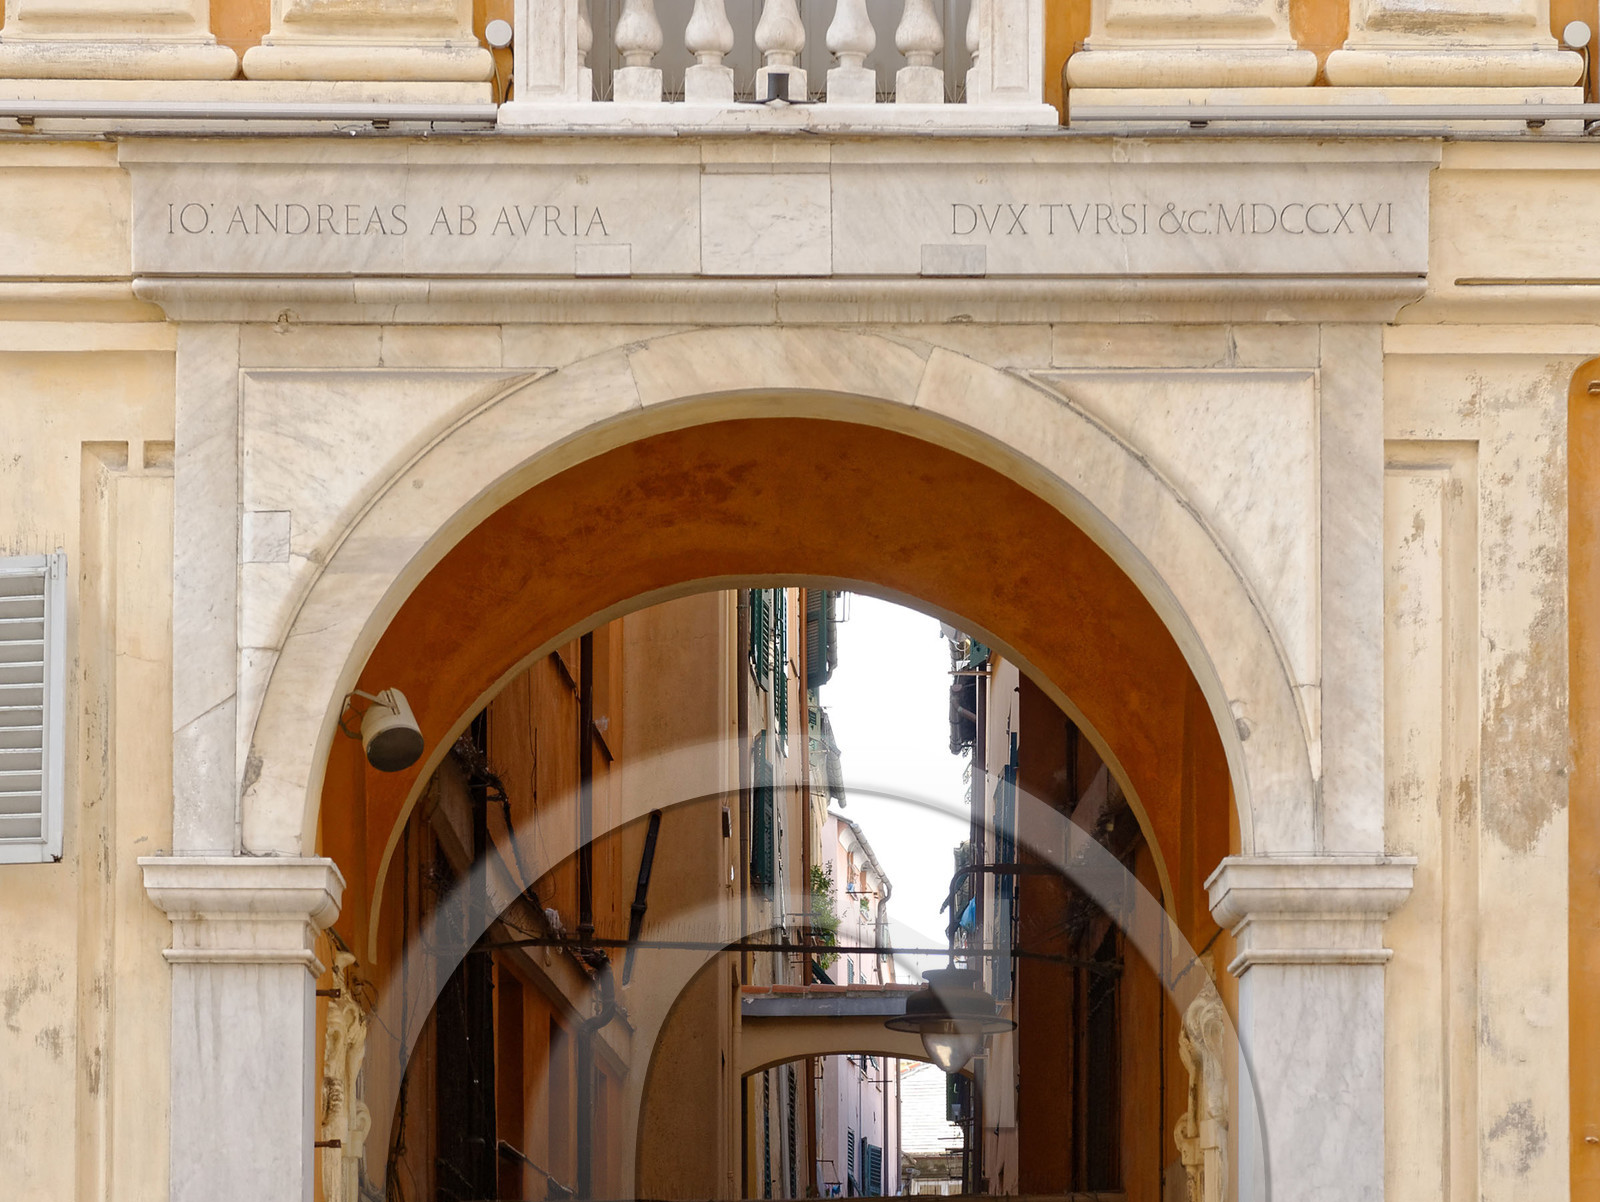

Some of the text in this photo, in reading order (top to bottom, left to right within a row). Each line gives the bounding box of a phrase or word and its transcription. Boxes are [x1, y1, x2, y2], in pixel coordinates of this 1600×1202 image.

[226, 204, 408, 235] ANDREAS
[429, 205, 477, 236] AB
[490, 205, 610, 236] AVRIA
[951, 203, 1029, 235] DVX
[1040, 203, 1149, 235] TVRSI
